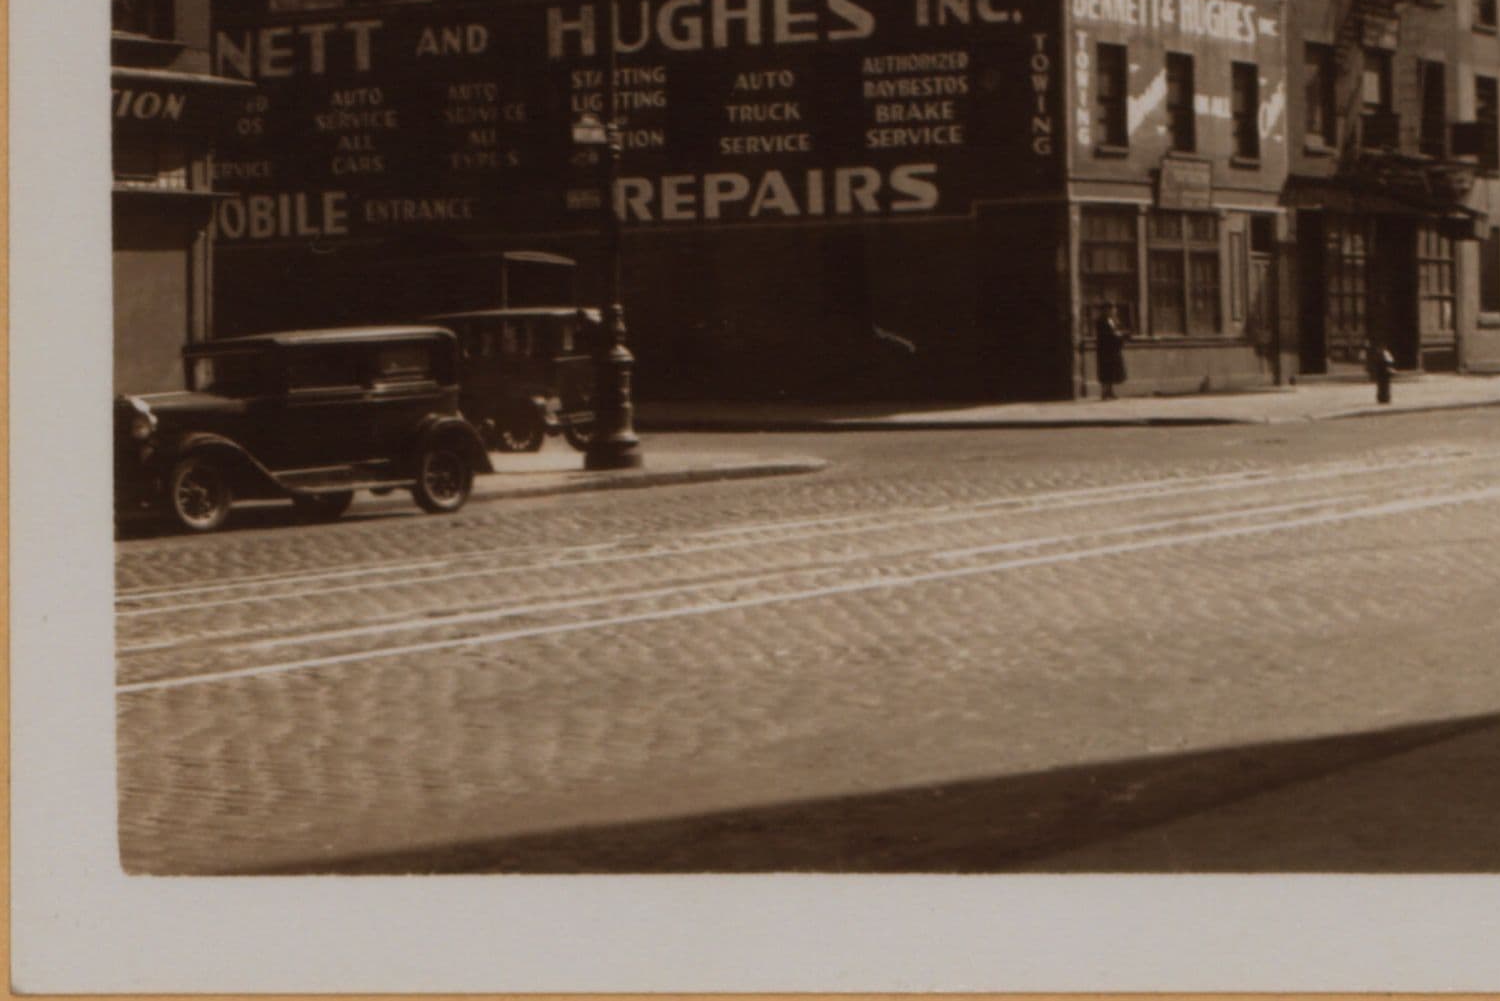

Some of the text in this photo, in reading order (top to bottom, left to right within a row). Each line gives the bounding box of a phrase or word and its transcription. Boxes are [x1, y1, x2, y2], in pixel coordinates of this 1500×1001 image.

[416, 23, 489, 57] AND
[861, 51, 970, 76] AUTHORIZED
[733, 69, 795, 91] AUTO
[862, 75, 969, 99] RAYBESTOS
[1075, 30, 1091, 146] TOWING
[330, 87, 384, 107] AUTO
[1031, 32, 1053, 156] TOWING
[314, 109, 398, 131] SERVICE
[725, 102, 801, 124] TRUCK
[875, 100, 956, 124] BRAKE
[337, 135, 376, 152] ALL
[720, 133, 812, 155] SERVICE
[866, 124, 963, 149] SERVICE
[331, 154, 385, 176] CARS
[612, 163, 940, 223] REPAIRS
[213, 191, 474, 240] OBILE ENTRANCE
